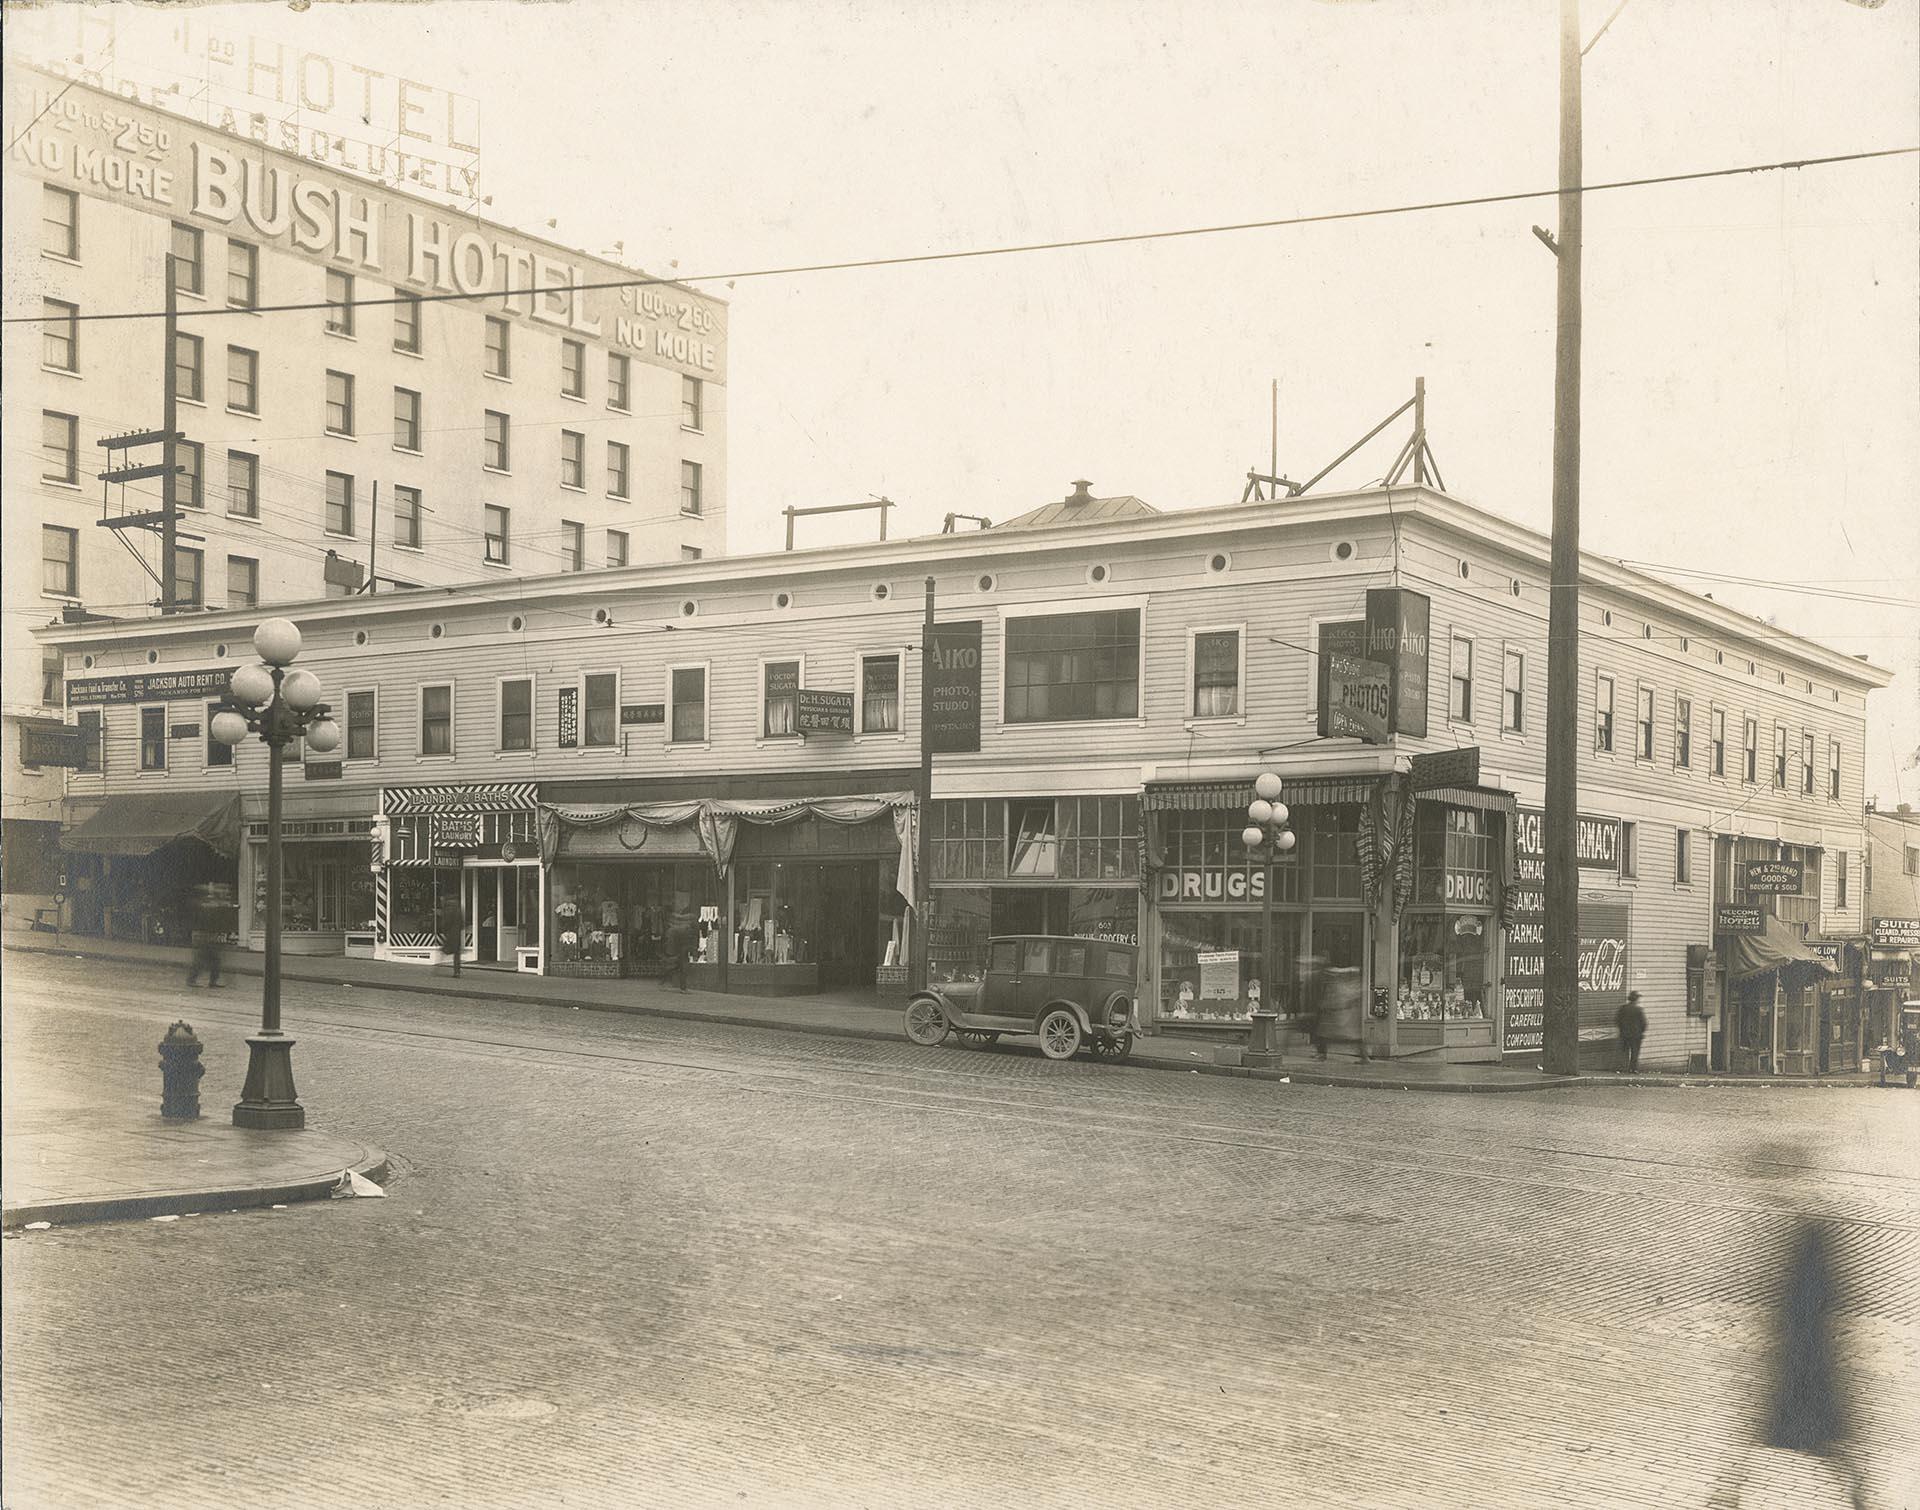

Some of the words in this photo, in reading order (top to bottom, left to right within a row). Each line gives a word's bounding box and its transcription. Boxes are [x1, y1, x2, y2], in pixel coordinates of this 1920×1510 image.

[248, 35, 480, 153] HOTEL
[11, 124, 64, 172] NO
[74, 144, 174, 206] MORE
[189, 141, 383, 273] BUSH
[407, 211, 603, 339] HOTEL
[616, 316, 646, 350] NO
[656, 329, 715, 373] MORE
[1368, 616, 1396, 656] AIKO
[1400, 615, 1426, 656] AIKO
[932, 637, 978, 670] AIKO
[147, 677, 177, 690] JACKSON
[177, 675, 195, 688] AUTO
[196, 674, 214, 686] RENT
[768, 682, 797, 690] SUGATA
[932, 686, 970, 697] PHOTO
[820, 696, 852, 707] SUGATA
[932, 701, 969, 712] STUDIO
[1342, 684, 1388, 719] PHOTOS
[412, 794, 460, 805] LAUNDRY
[474, 791, 510, 802] BATHS
[441, 820, 473, 831] BATHS
[441, 832, 473, 840] LAUNDRY
[1517, 813, 1544, 854] AGL
[1576, 820, 1618, 861] RMACY
[1749, 866, 1762, 877] NEW
[1781, 866, 1798, 878] HAND
[1761, 874, 1787, 883] GOODS
[1161, 872, 1265, 898] DRUGS
[1750, 883, 1773, 891] BOUGHT
[1719, 915, 1760, 925] HOTEL
[1879, 920, 1919, 928] SUITS
[1824, 946, 1837, 954] LOW
[1505, 988, 1544, 1008] PRESCRIPTIO
[1506, 1032, 1544, 1046] COMPOUNDE
